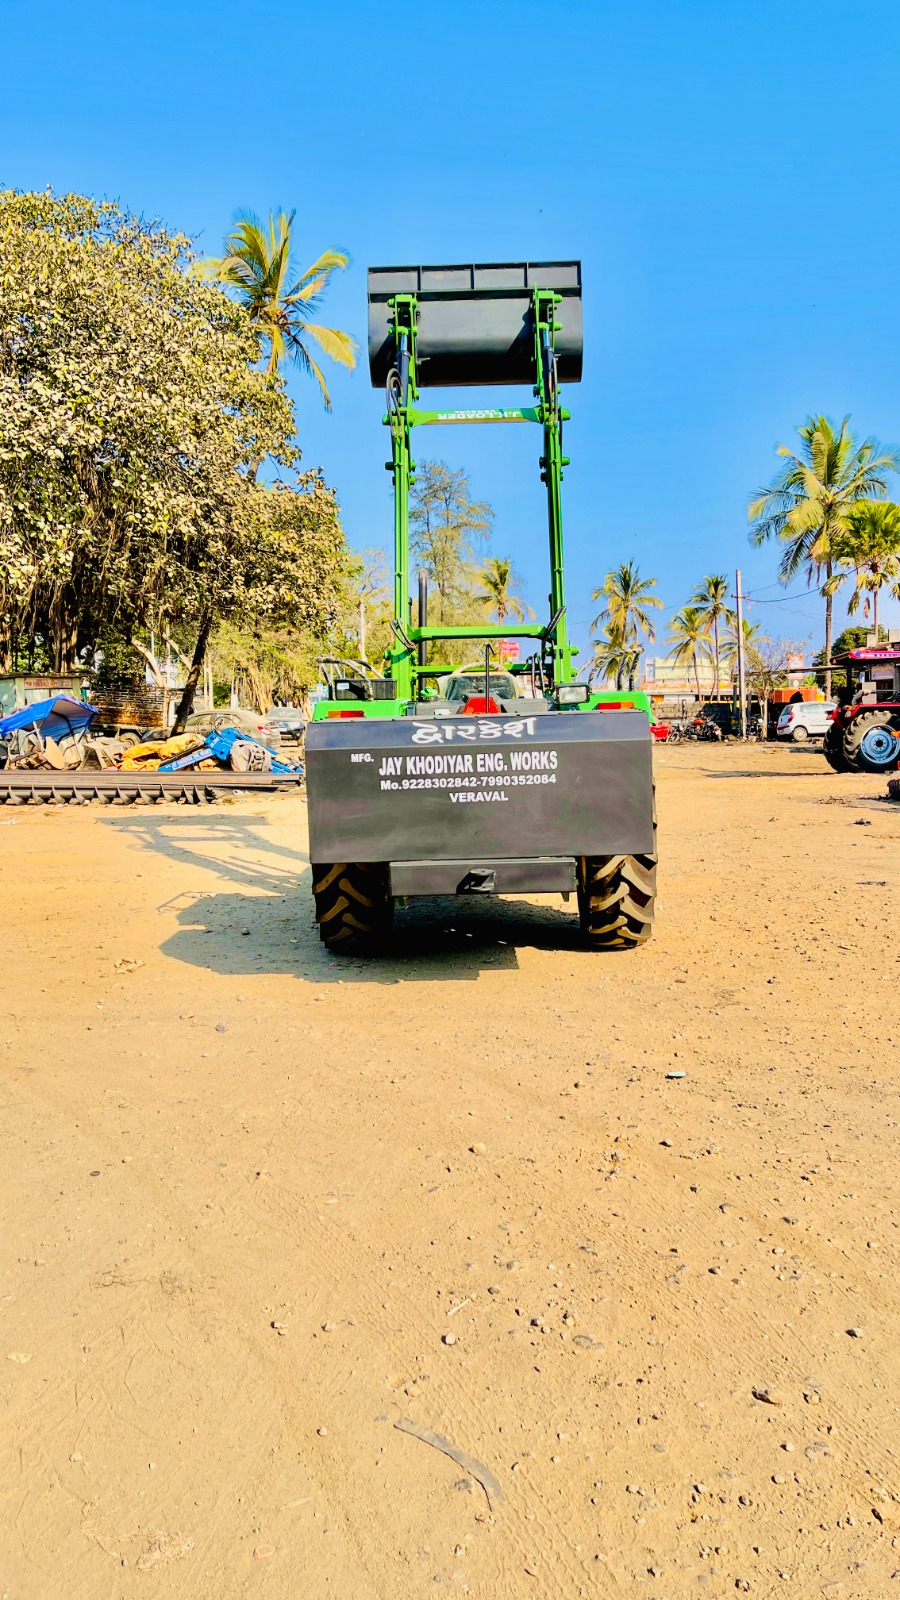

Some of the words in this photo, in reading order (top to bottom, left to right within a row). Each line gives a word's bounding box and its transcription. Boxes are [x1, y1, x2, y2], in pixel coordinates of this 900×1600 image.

[350, 752, 375, 763] MFG.
[378, 756, 403, 776] JAY
[406, 754, 474, 775] KHODIYAR
[476, 752, 508, 773] ENG.
[510, 750, 559, 771] WORKS
[380, 774, 557, 791] Mo.9228302842-7990352084
[449, 790, 509, 803] VERAVAL
